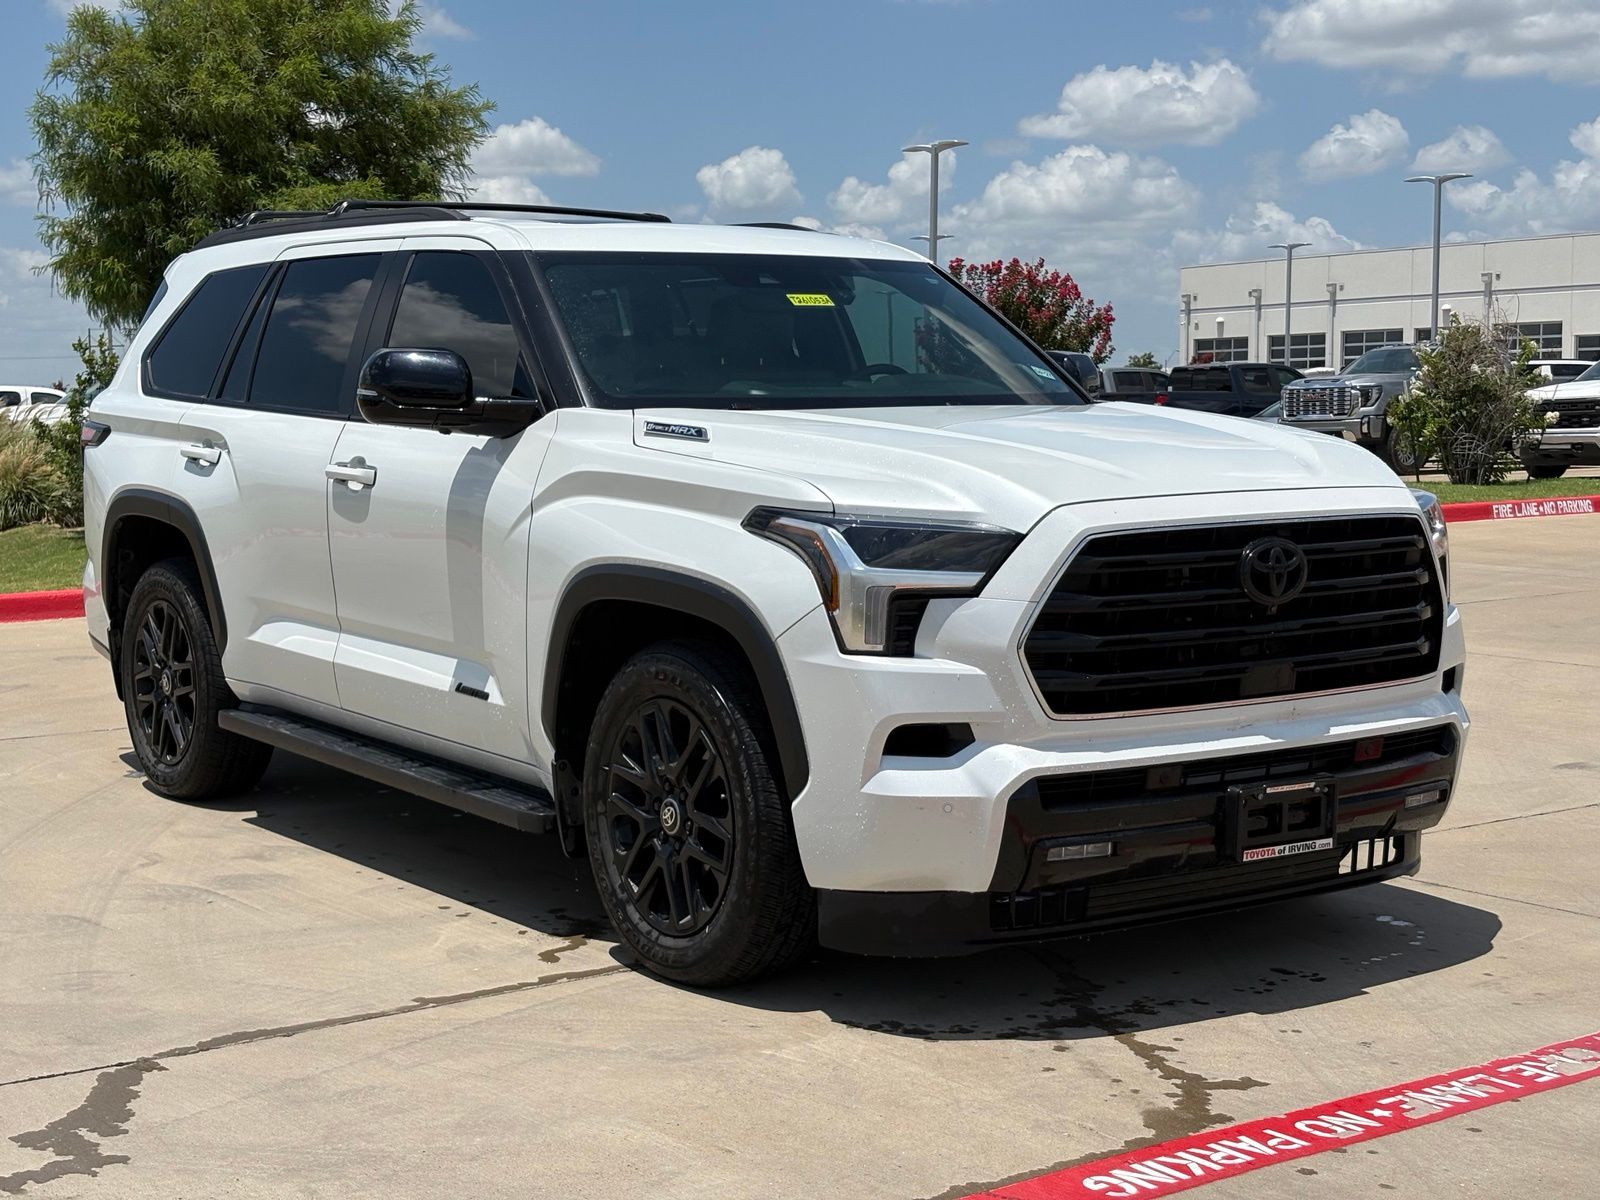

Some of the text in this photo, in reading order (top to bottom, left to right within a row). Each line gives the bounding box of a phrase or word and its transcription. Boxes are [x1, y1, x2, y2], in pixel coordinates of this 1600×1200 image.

[669, 425, 698, 436] MAX
[1492, 499, 1593, 519] FIRE LANE NO PARKING
[1244, 848, 1277, 860] TOYOTA
[1277, 846, 1287, 856] of
[1294, 1110, 1384, 1139] NO
[1082, 1128, 1312, 1197] PARKING
